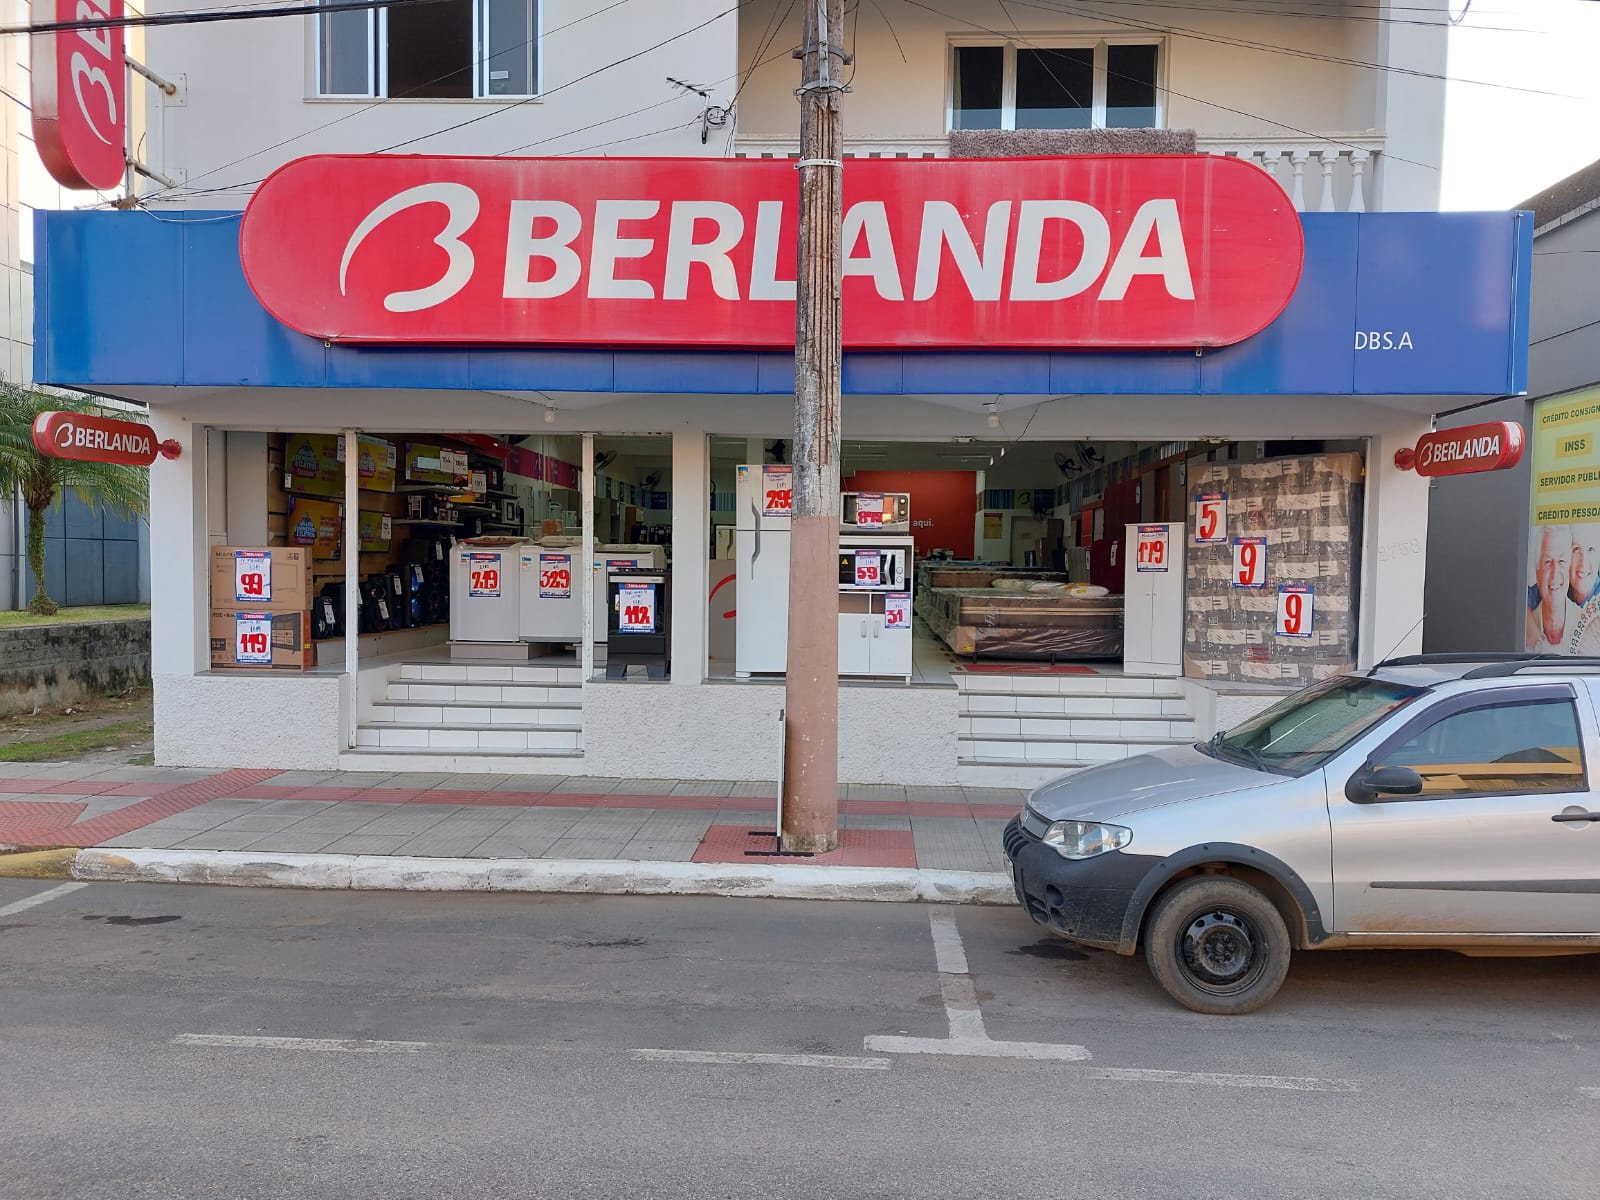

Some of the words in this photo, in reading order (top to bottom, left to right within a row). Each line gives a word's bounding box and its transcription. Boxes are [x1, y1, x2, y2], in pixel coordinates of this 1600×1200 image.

[503, 199, 1195, 301] BERLANDA
[1355, 331, 1414, 350] DBS.A
[75, 428, 150, 455] BERLANDA
[1433, 435, 1500, 462] BERLANDA
[1564, 439, 1586, 452] INSS
[1540, 475, 1576, 487] SERVIDOR
[1199, 503, 1221, 539] 5
[857, 566, 879, 580] 59
[1238, 542, 1257, 585] 9
[240, 573, 263, 595] 99
[540, 569, 571, 589] 329
[1284, 594, 1302, 634] 9
[240, 633, 267, 653] 119
